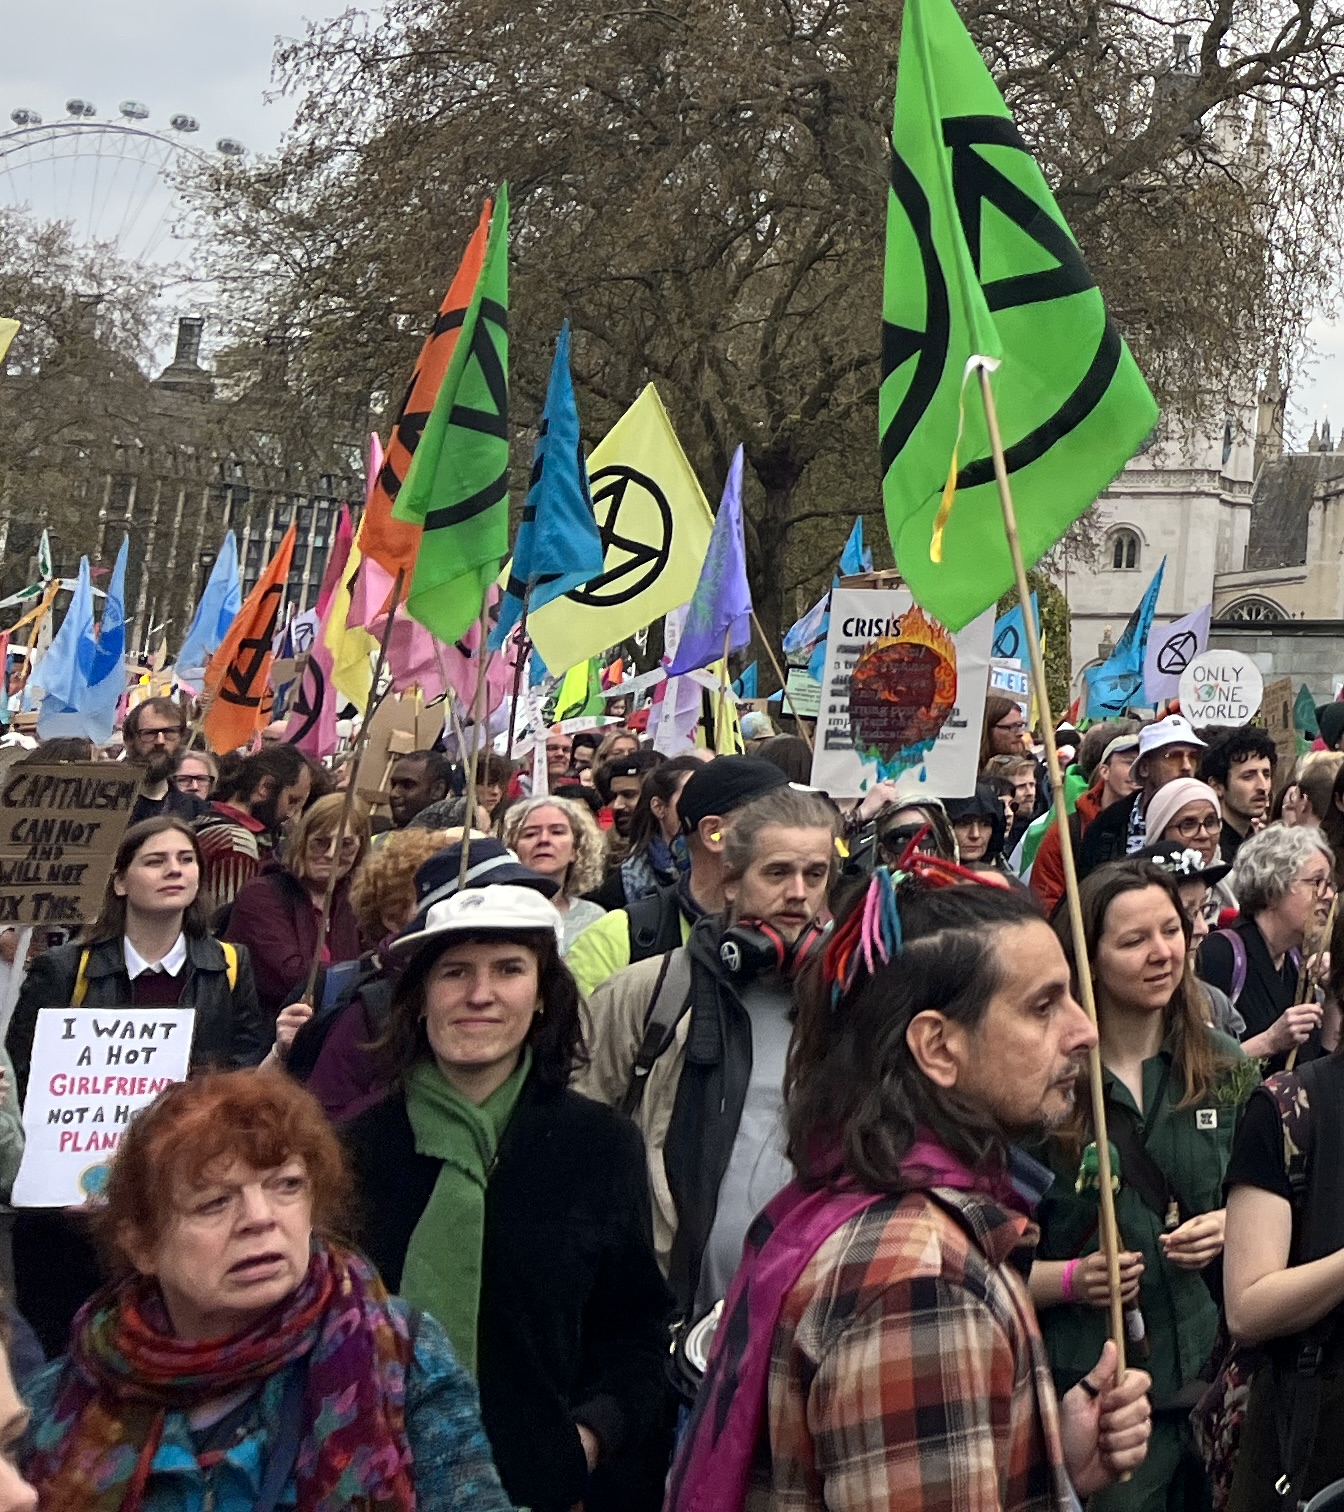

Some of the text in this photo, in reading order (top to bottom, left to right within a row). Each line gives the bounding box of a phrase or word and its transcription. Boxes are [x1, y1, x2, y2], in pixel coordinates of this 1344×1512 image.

[842, 617, 902, 638] CRISIS
[1192, 665, 1244, 683] ONLY
[1188, 703, 1249, 720] WORLD
[1, 772, 137, 811] CAPITALISM
[10, 817, 101, 844] CANNOT
[26, 844, 64, 861] AND
[47, 862, 89, 882] NOT
[60, 1017, 178, 1040] I WANT
[76, 1045, 157, 1067] A HOT
[46, 1106, 89, 1125] NOT
[92, 1106, 105, 1124] A
[58, 1130, 119, 1153] PLAN
